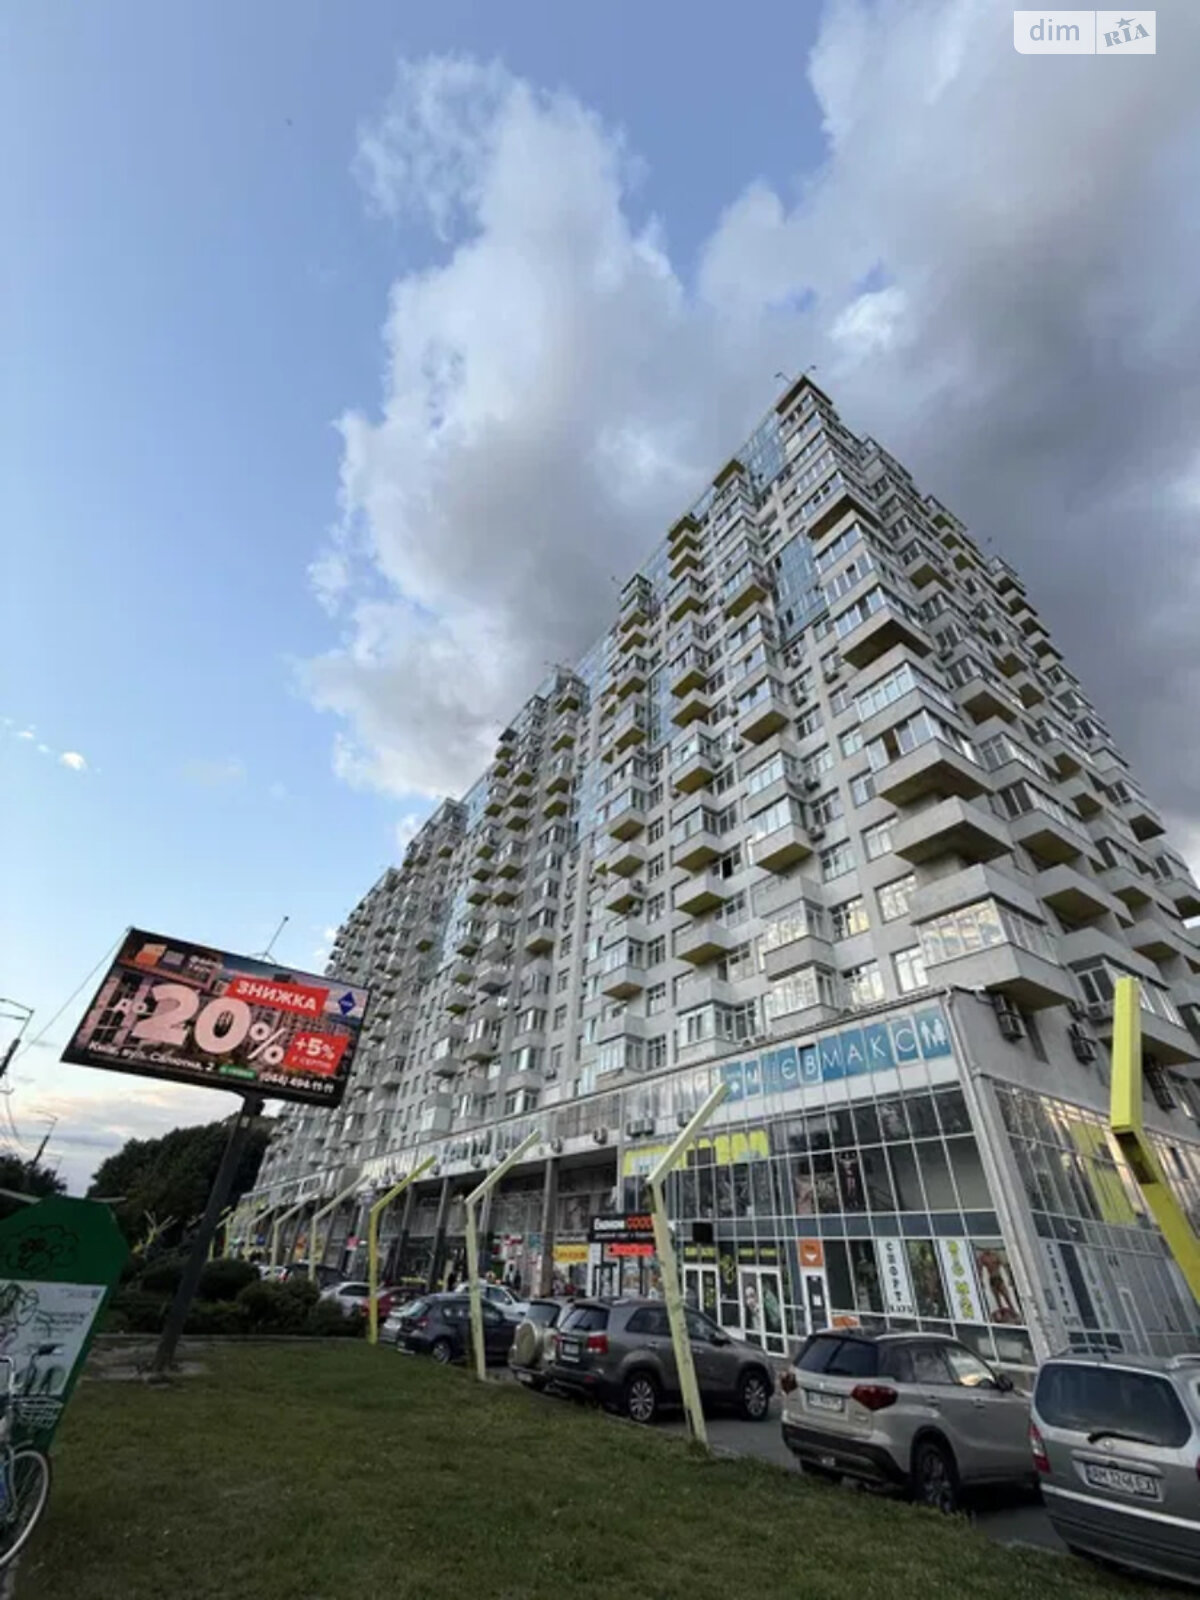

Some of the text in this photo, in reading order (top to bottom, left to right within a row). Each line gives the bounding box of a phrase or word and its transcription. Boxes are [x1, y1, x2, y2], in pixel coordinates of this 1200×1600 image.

[236, 980, 317, 1011] ЗНИЖКА
[131, 983, 286, 1065] 20%
[295, 1038, 335, 1061] +5%
